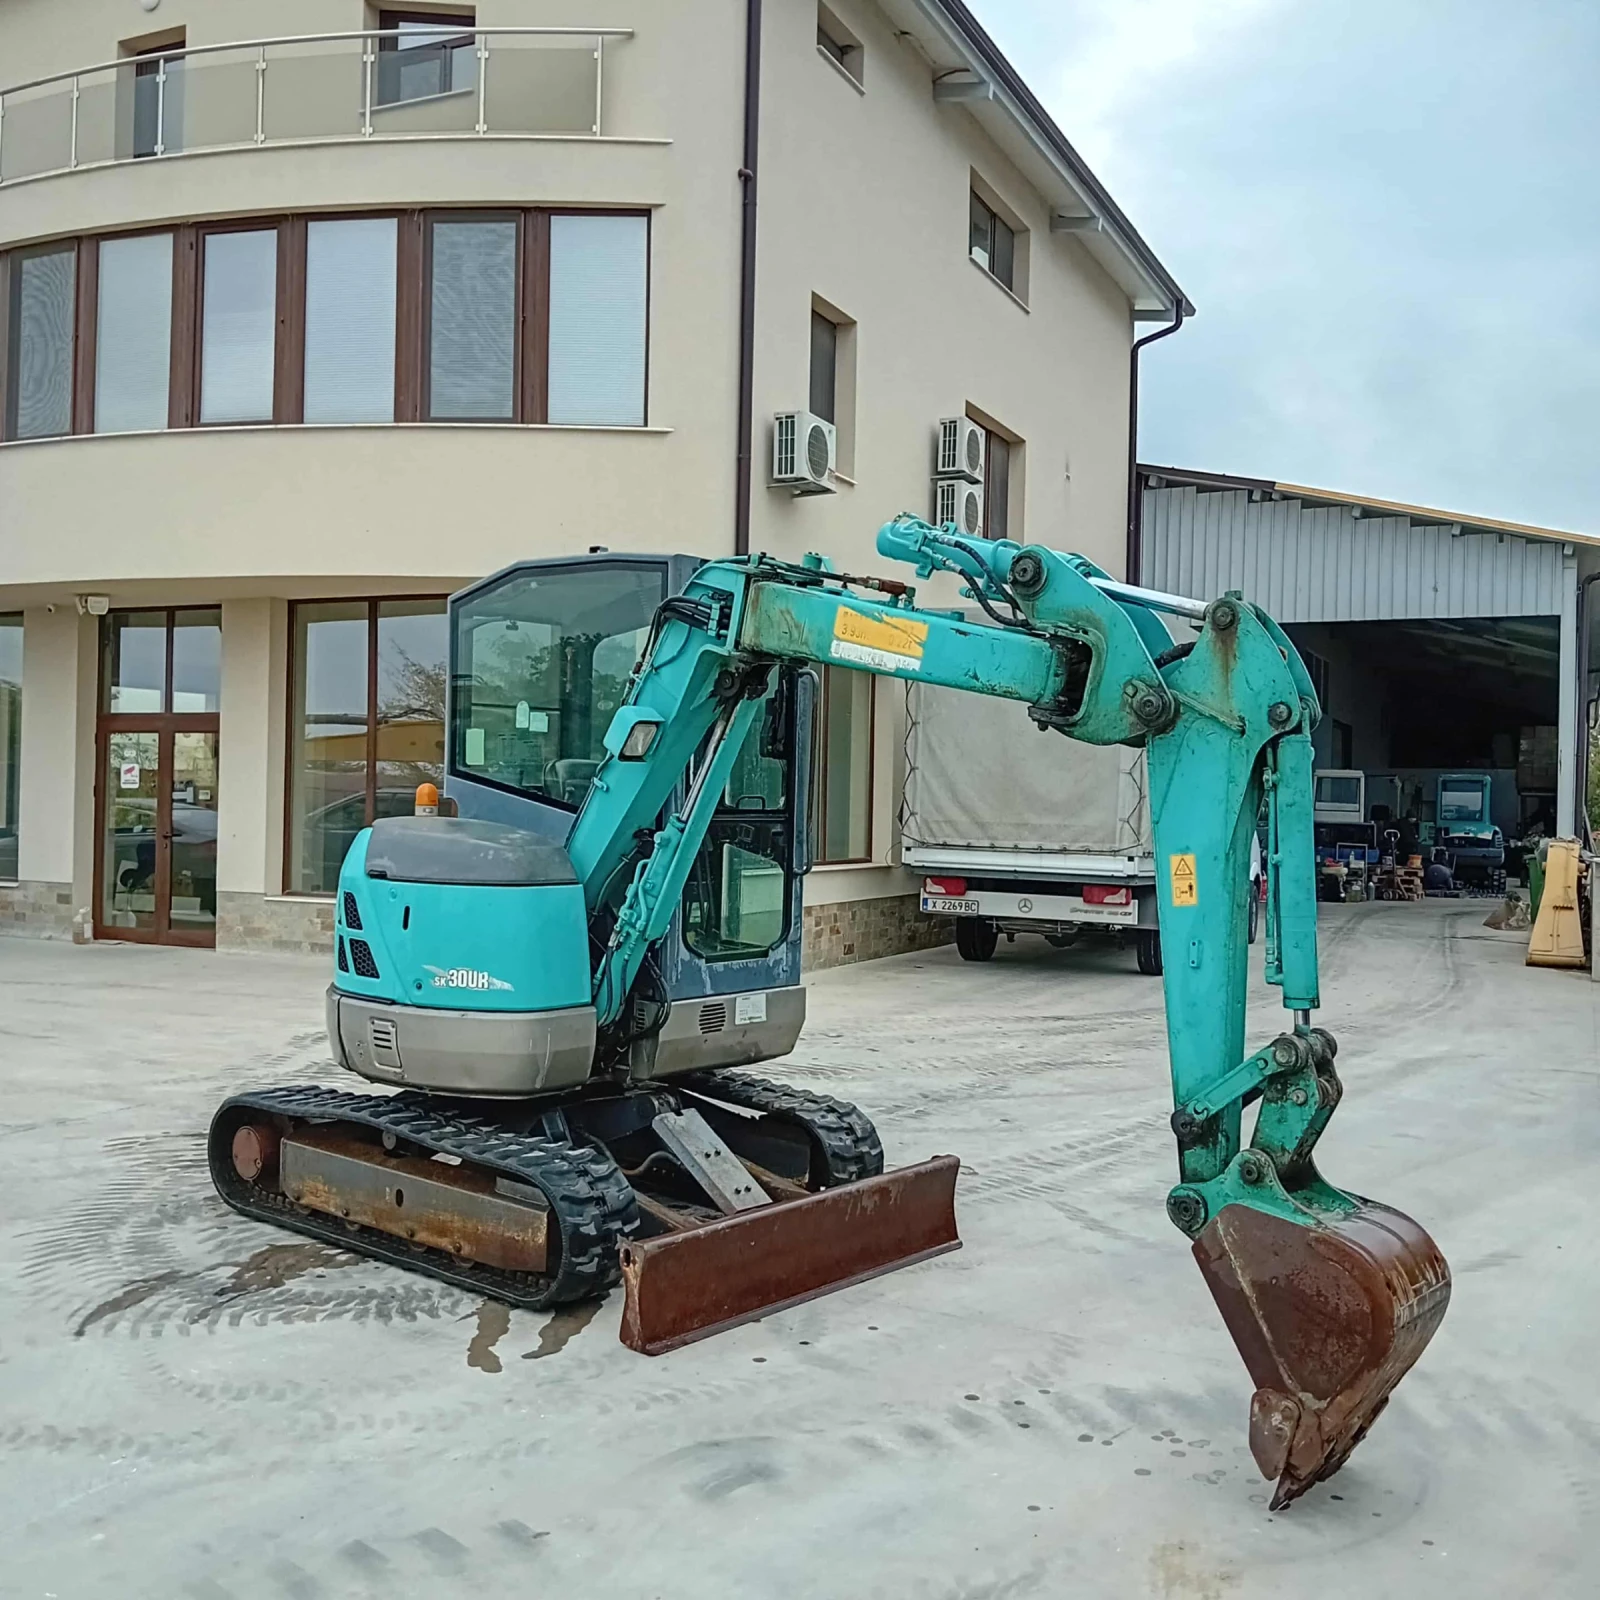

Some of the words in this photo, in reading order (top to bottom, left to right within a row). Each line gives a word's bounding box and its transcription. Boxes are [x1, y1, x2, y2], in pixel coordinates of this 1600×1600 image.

[931, 900, 938, 910] X
[941, 900, 964, 911] 2269
[434, 976, 447, 987] SK
[448, 968, 489, 989] 30UR
